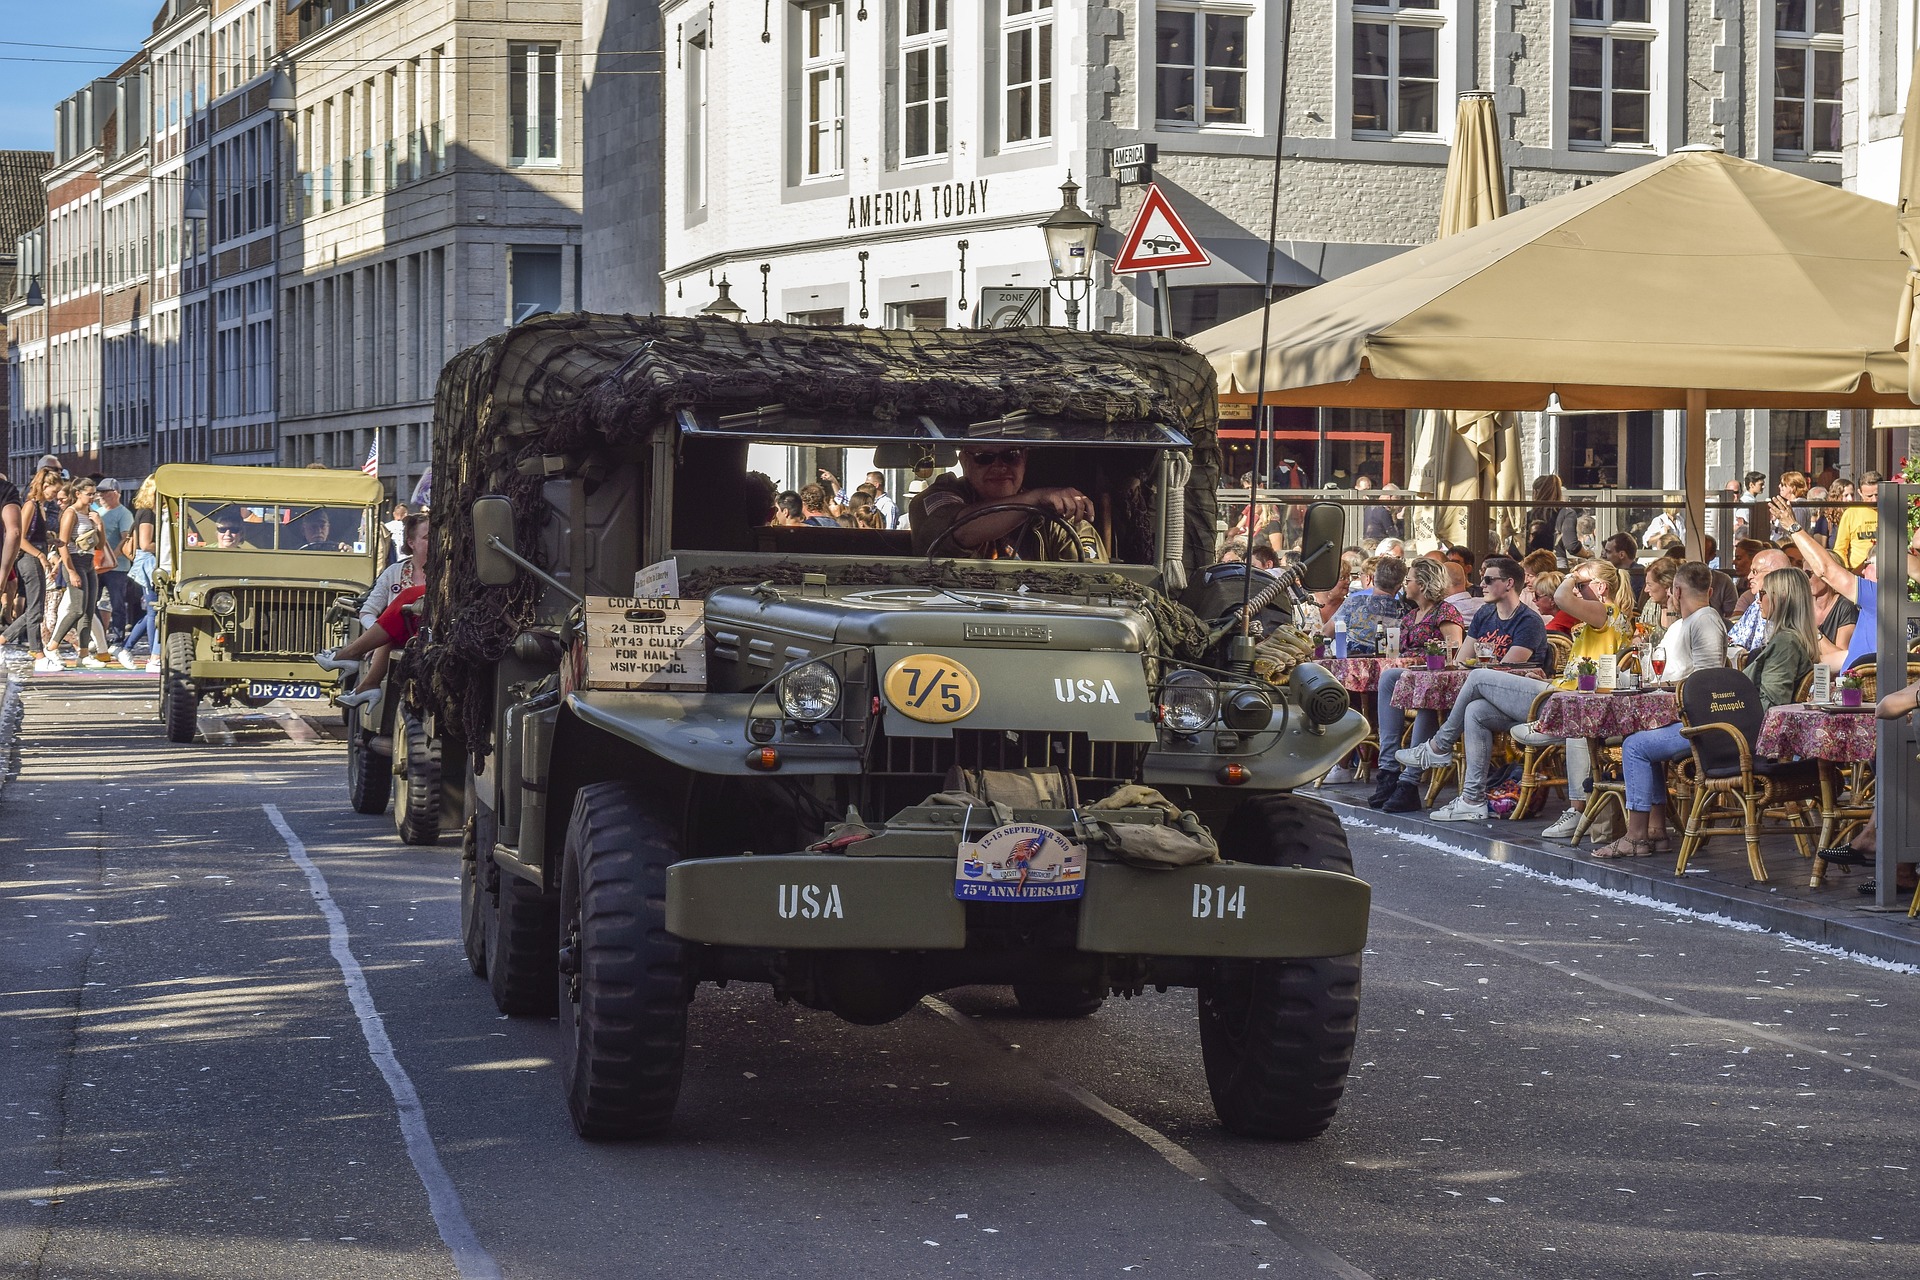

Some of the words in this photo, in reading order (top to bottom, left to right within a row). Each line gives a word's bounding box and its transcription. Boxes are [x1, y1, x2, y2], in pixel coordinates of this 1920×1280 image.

[1115, 146, 1144, 165] AMERICA
[1120, 166, 1139, 184] TODAY
[848, 189, 922, 229] AMERICA
[932, 179, 988, 219] TODAY
[999, 293, 1025, 302] ZONE
[608, 598, 681, 610] COCA-COLA
[611, 624, 627, 634] 24
[633, 625, 684, 636] BOTTLES
[973, 627, 1042, 638] DODGE
[611, 636, 644, 648] WT43
[616, 650, 638, 660] FOR
[644, 651, 681, 661] HAIL-L
[252, 684, 318, 698] DR-73-70
[903, 668, 962, 712] 7/5
[1054, 678, 1121, 704] USA
[1710, 700, 1745, 712] Monopole
[981, 831, 1003, 850] 12-15
[1004, 826, 1055, 840] SEPTEMBER
[1053, 837, 1070, 852] 2019
[962, 884, 987, 897] 75TH
[987, 884, 1079, 898] ANNIVERSARY
[778, 884, 844, 918] USA
[1192, 884, 1246, 919] B14
